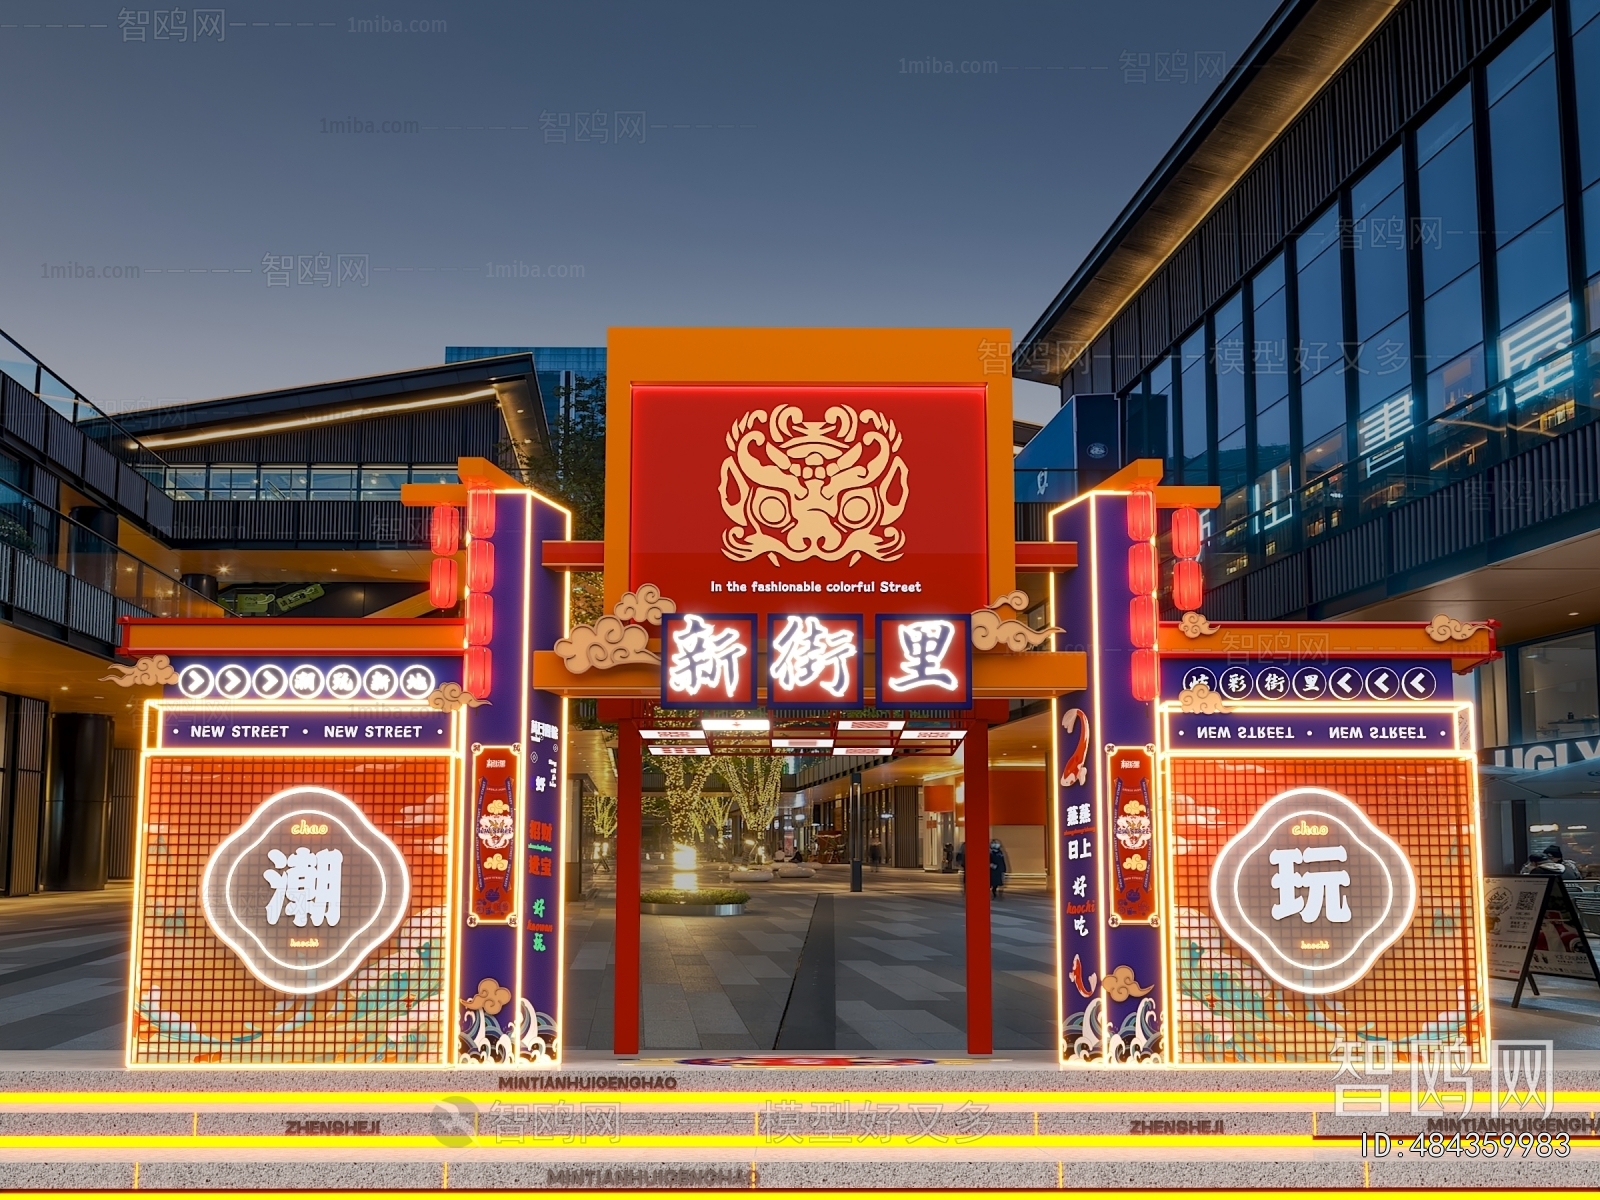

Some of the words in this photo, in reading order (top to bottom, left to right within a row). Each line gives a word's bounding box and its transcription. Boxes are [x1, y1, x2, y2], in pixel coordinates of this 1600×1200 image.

[710, 581, 722, 592] In
[726, 581, 747, 592] the
[751, 581, 821, 592] fashionable
[826, 581, 875, 592] colorful
[879, 581, 922, 592] Street
[669, 614, 959, 697] 新街里
[191, 726, 225, 738] NEW
[232, 726, 289, 738] STREET
[324, 726, 359, 738] NEW
[365, 726, 423, 738] STREET
[291, 819, 328, 835] chao
[1292, 820, 1329, 835] chao
[1068, 838, 1092, 860] 日上
[263, 847, 343, 927] 潮
[1072, 875, 1087, 898] 好
[1269, 845, 1351, 923] 玩
[1066, 900, 1096, 914] haochi
[1074, 915, 1089, 936] 吃
[498, 1076, 678, 1089] MINTIANHUIGENGHAO
[285, 1120, 381, 1134] ZHENSHEJI
[1130, 1120, 1224, 1134] ZHENSHEJI
